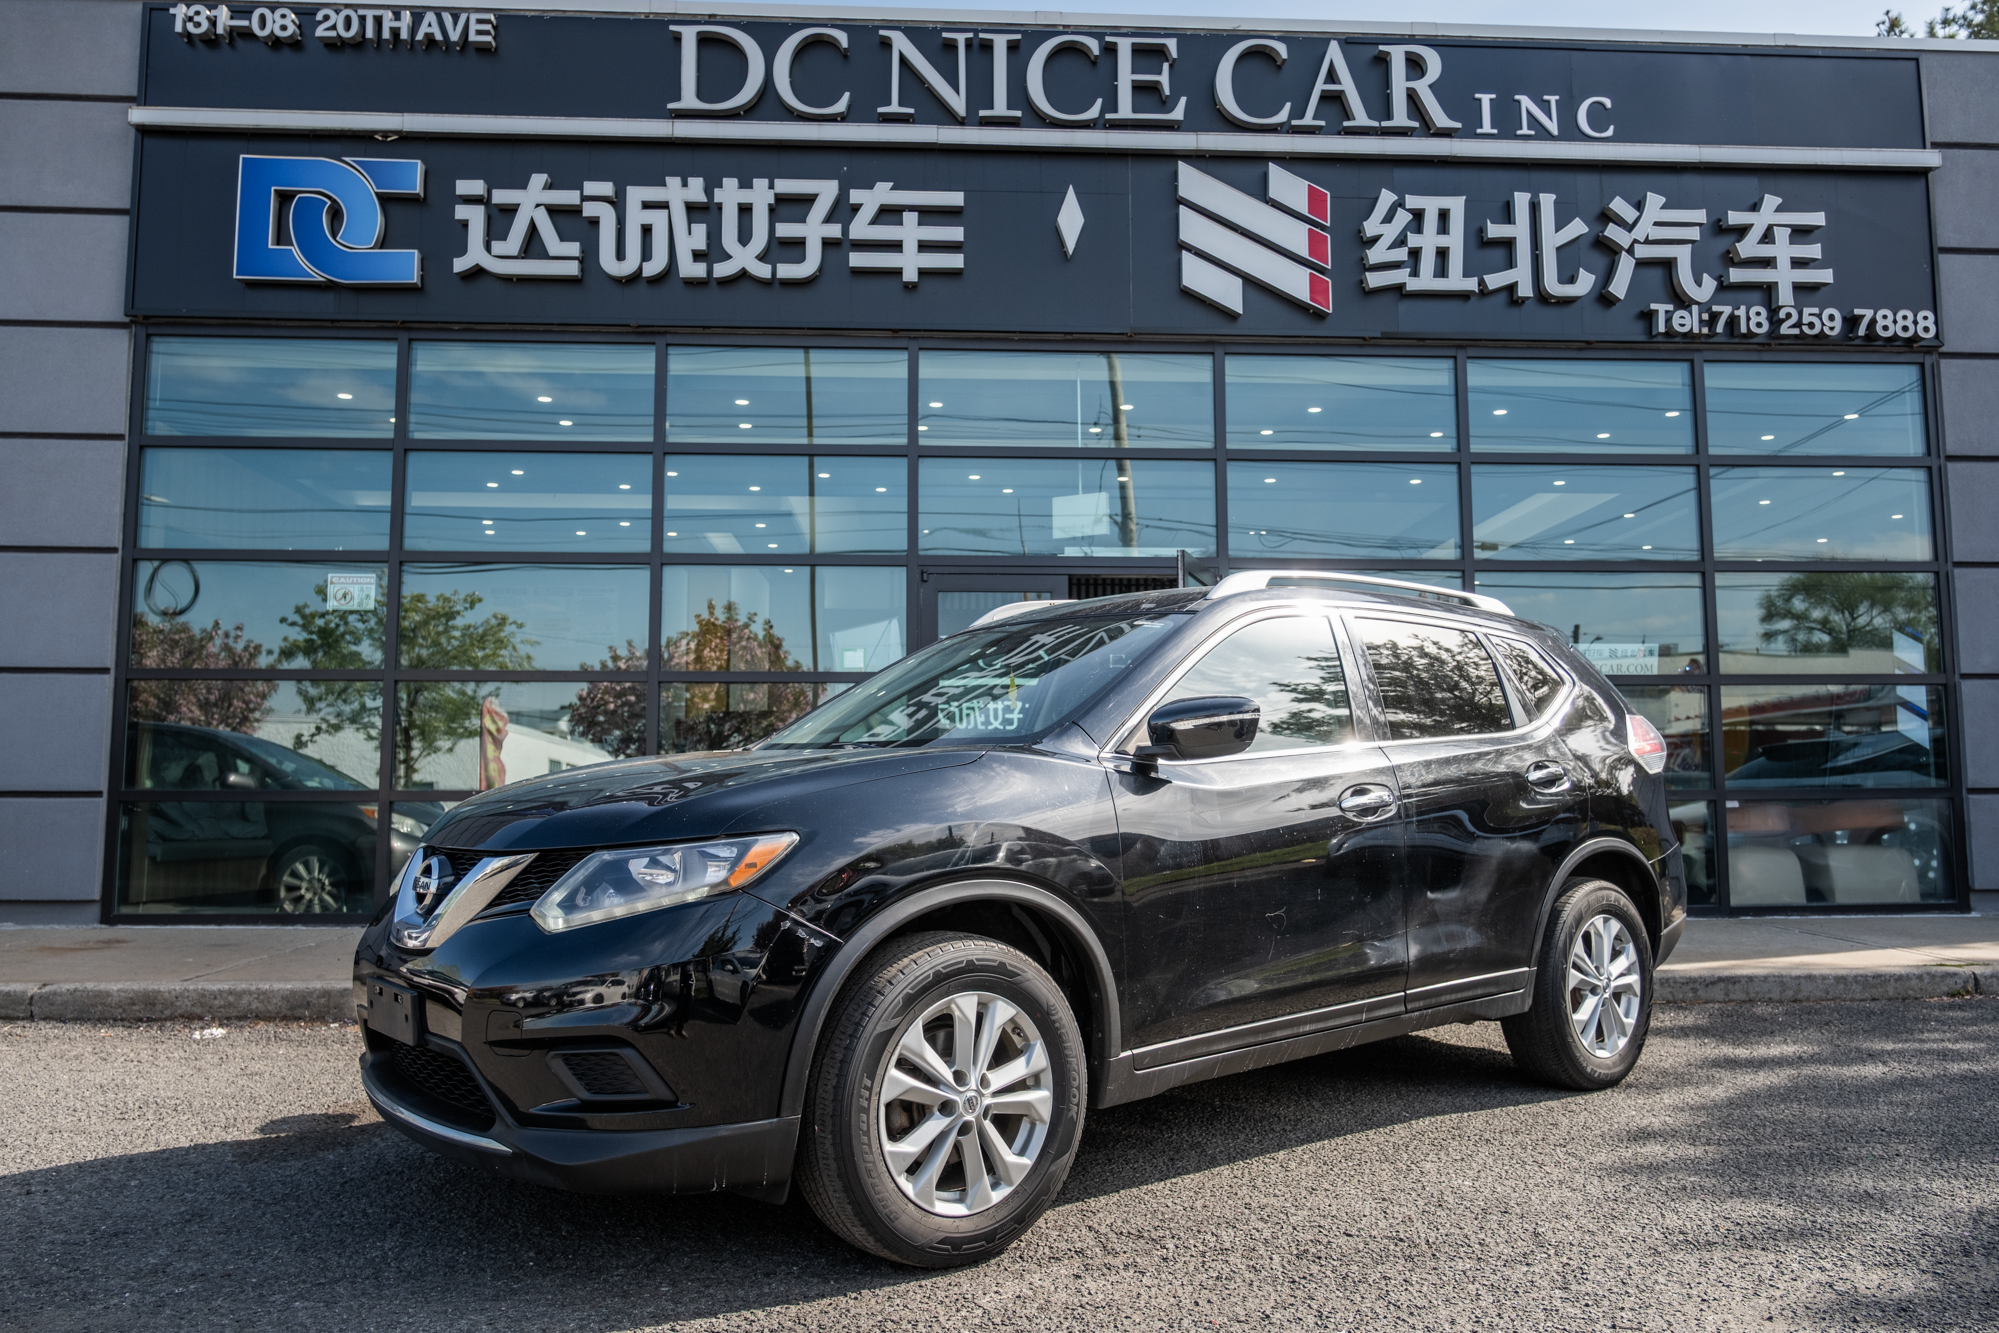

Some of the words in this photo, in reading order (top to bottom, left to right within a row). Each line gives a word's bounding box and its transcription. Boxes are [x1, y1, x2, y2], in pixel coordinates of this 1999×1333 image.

[168, 3, 302, 45] 131-08
[414, 11, 497, 52] AVE
[666, 24, 851, 121] DC
[876, 29, 1188, 129] NICE
[1213, 37, 1463, 136] CAR
[1473, 92, 1616, 140] INC
[233, 154, 426, 289] DC
[452, 173, 965, 287] 达诚好车
[1360, 188, 1834, 307] 纽北汽车
[1778, 305, 1843, 340] 259
[1852, 308, 1938, 344] 7888
